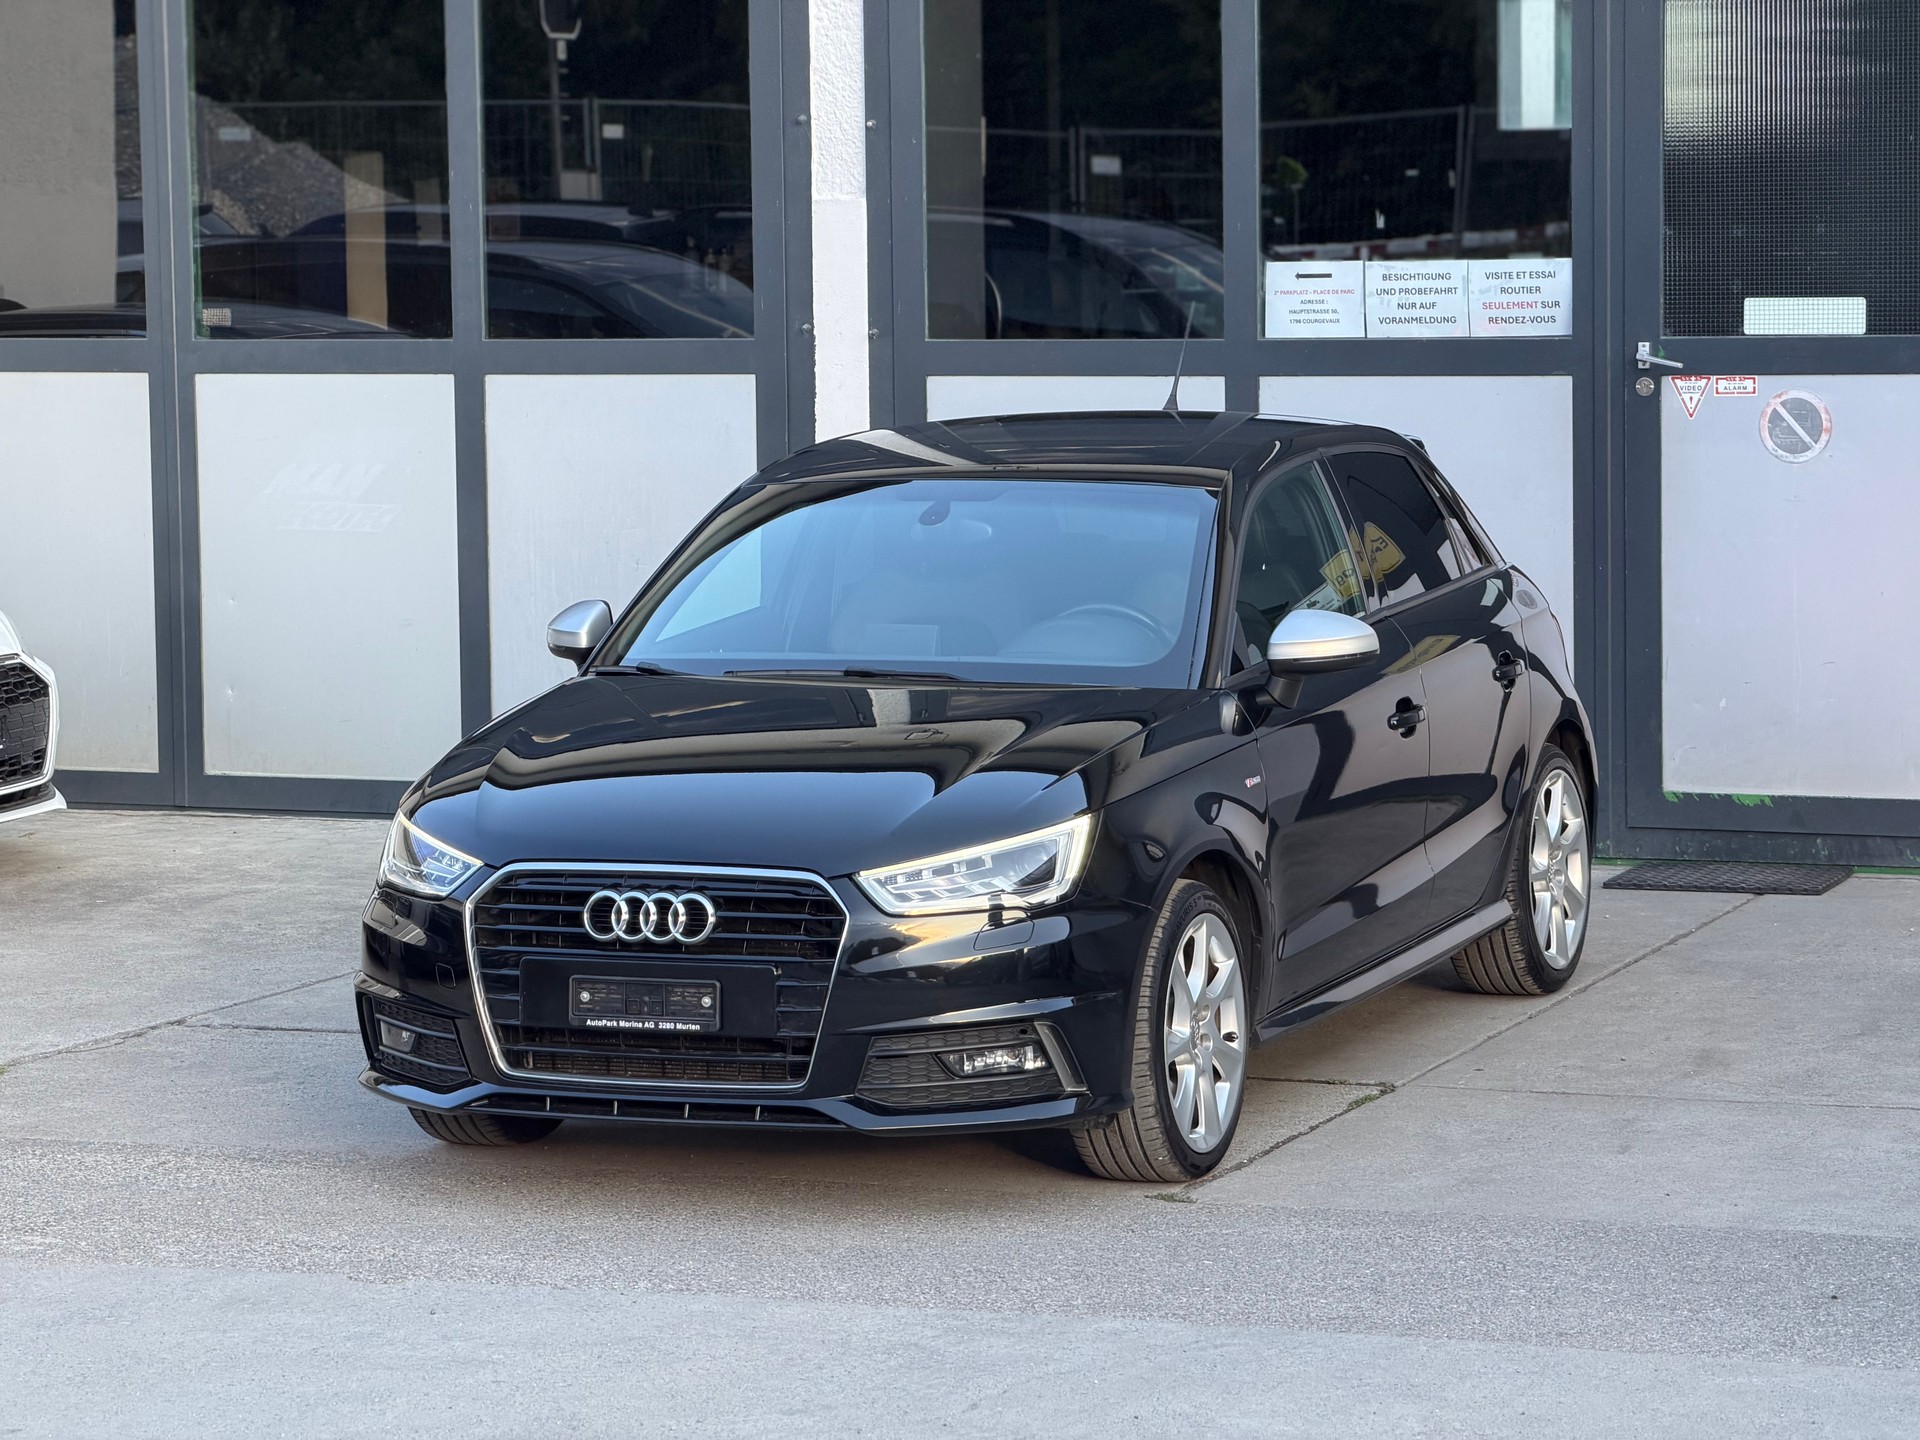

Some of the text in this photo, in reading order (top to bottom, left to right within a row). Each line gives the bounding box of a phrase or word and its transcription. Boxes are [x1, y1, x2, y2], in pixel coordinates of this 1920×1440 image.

[1382, 272, 1452, 281] BESICHTIGUNG
[1484, 270, 1556, 280] VISITE ET ESSAI
[1375, 287, 1458, 296] UND PROBEFAHRT
[1500, 286, 1542, 295] ROUTIER
[1397, 301, 1437, 310] NUR AUF
[1482, 300, 1561, 310] SEULEMENT SUR
[1378, 316, 1457, 324] VORANMELDUNG
[1488, 315, 1557, 324] RENDEZ-VOUS
[585, 1018, 618, 1027] AutoPark
[619, 1020, 643, 1028] Morina
[643, 1021, 655, 1029] AG
[676, 1022, 701, 1031] Murten
